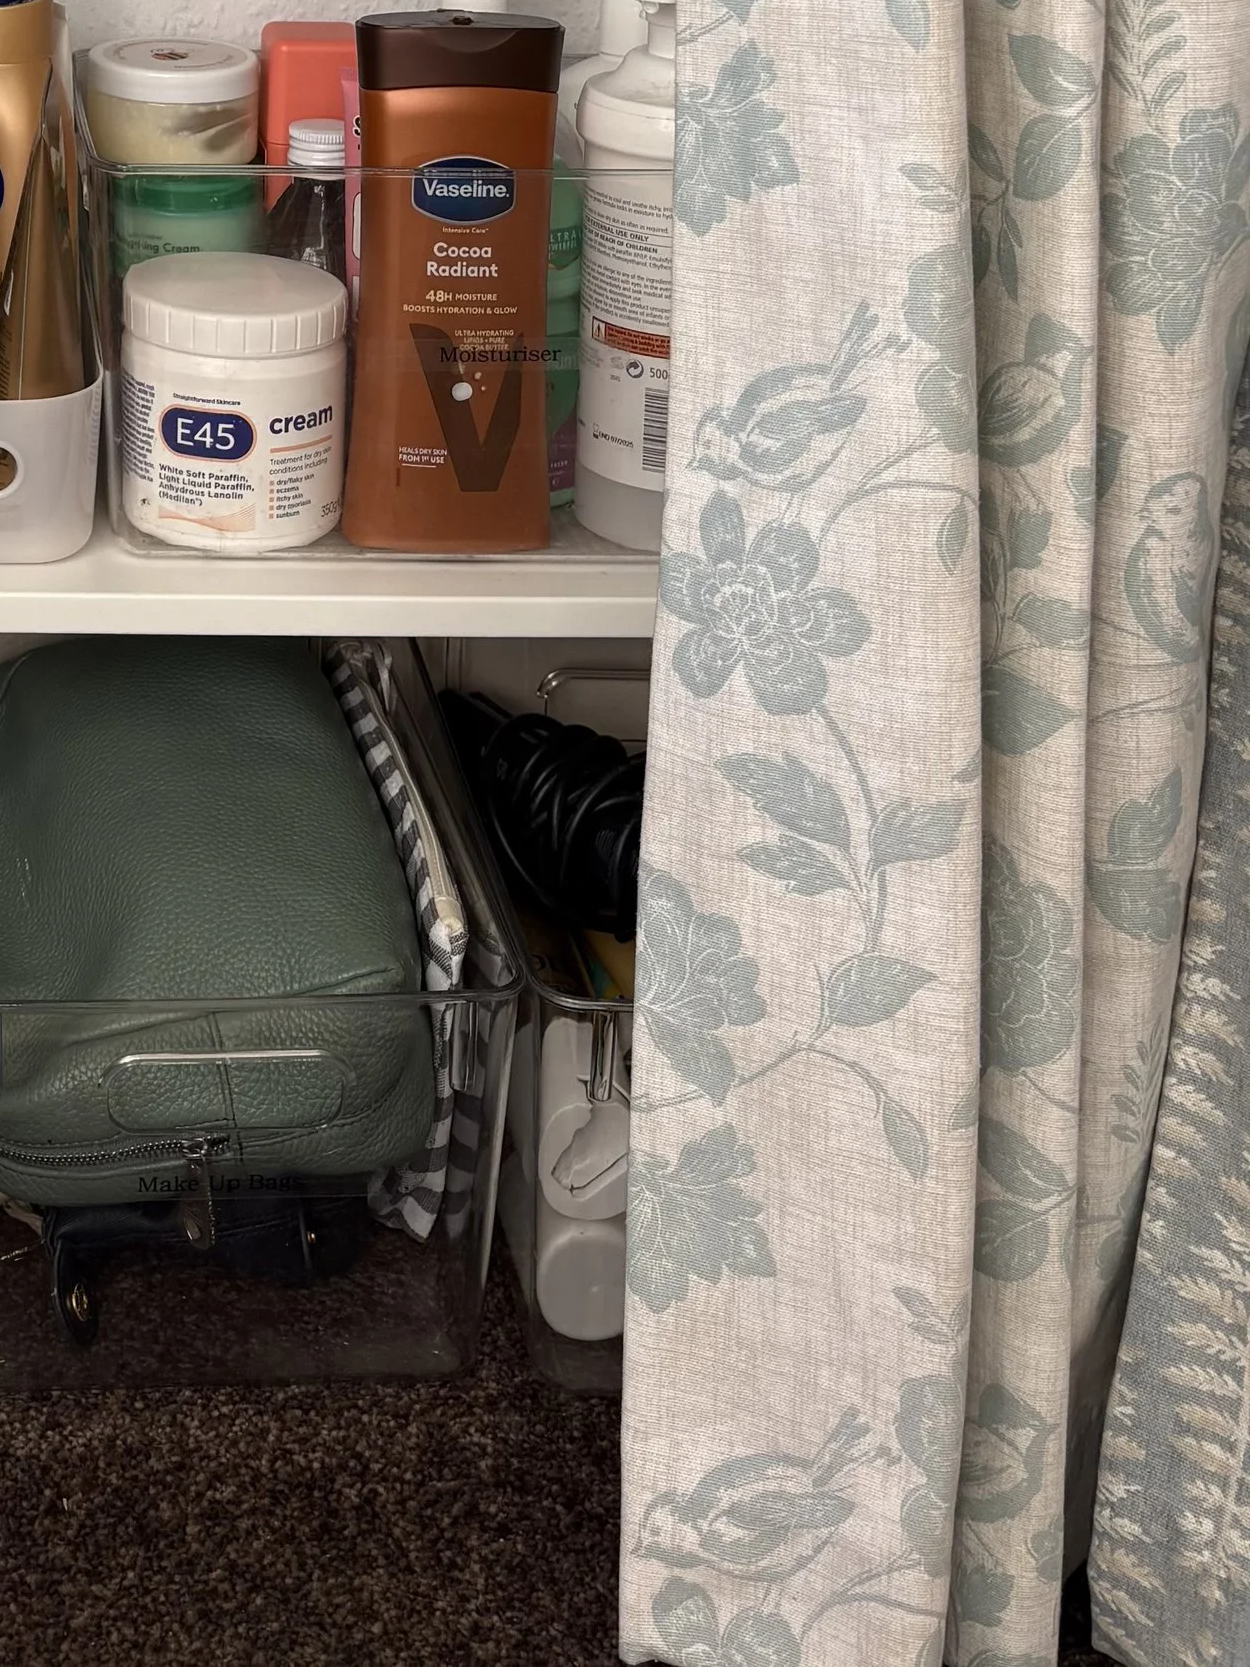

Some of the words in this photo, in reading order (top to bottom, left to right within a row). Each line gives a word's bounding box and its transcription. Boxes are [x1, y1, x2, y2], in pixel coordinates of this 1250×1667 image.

[615, 228, 628, 238] USE
[630, 232, 650, 243] ONLY
[162, 242, 200, 253] Cream
[433, 242, 492, 258] Cocoa
[617, 239, 624, 247] OF
[626, 242, 658, 254] CHILDREN
[426, 261, 498, 277] Radiant
[425, 290, 453, 302] 48H
[455, 293, 498, 301] MOISTURE
[403, 304, 435, 313] BOOSTS
[436, 306, 485, 314] HYDRATION
[486, 306, 492, 314] &
[440, 346, 562, 363] Moisturiser
[649, 367, 668, 380] 500
[269, 405, 333, 435] cream
[176, 417, 235, 451] E45
[269, 454, 303, 466] Treatment
[304, 452, 312, 461] for
[313, 449, 322, 459] dry
[398, 446, 419, 455] HEALS
[419, 447, 432, 455] DRY
[432, 448, 448, 456] SKIN
[269, 462, 303, 475] conditions
[304, 457, 328, 470] including
[398, 454, 420, 463] FROM
[430, 456, 445, 464] USE
[158, 463, 184, 476] White
[186, 470, 206, 480] Soft
[208, 471, 249, 483] Paraffin,
[158, 472, 180, 485] Light
[182, 478, 212, 490] Liquid
[214, 482, 255, 492] Paraffin,
[276, 485, 299, 494] eczema
[158, 481, 205, 498] Anhydrous
[207, 489, 244, 500] Lanolin
[276, 494, 291, 503] itchy
[291, 492, 303, 500] skin
[275, 503, 286, 511] dry
[138, 1176, 199, 1192] Make
[208, 1175, 241, 1192] Up
[248, 1174, 305, 1192] Bags
